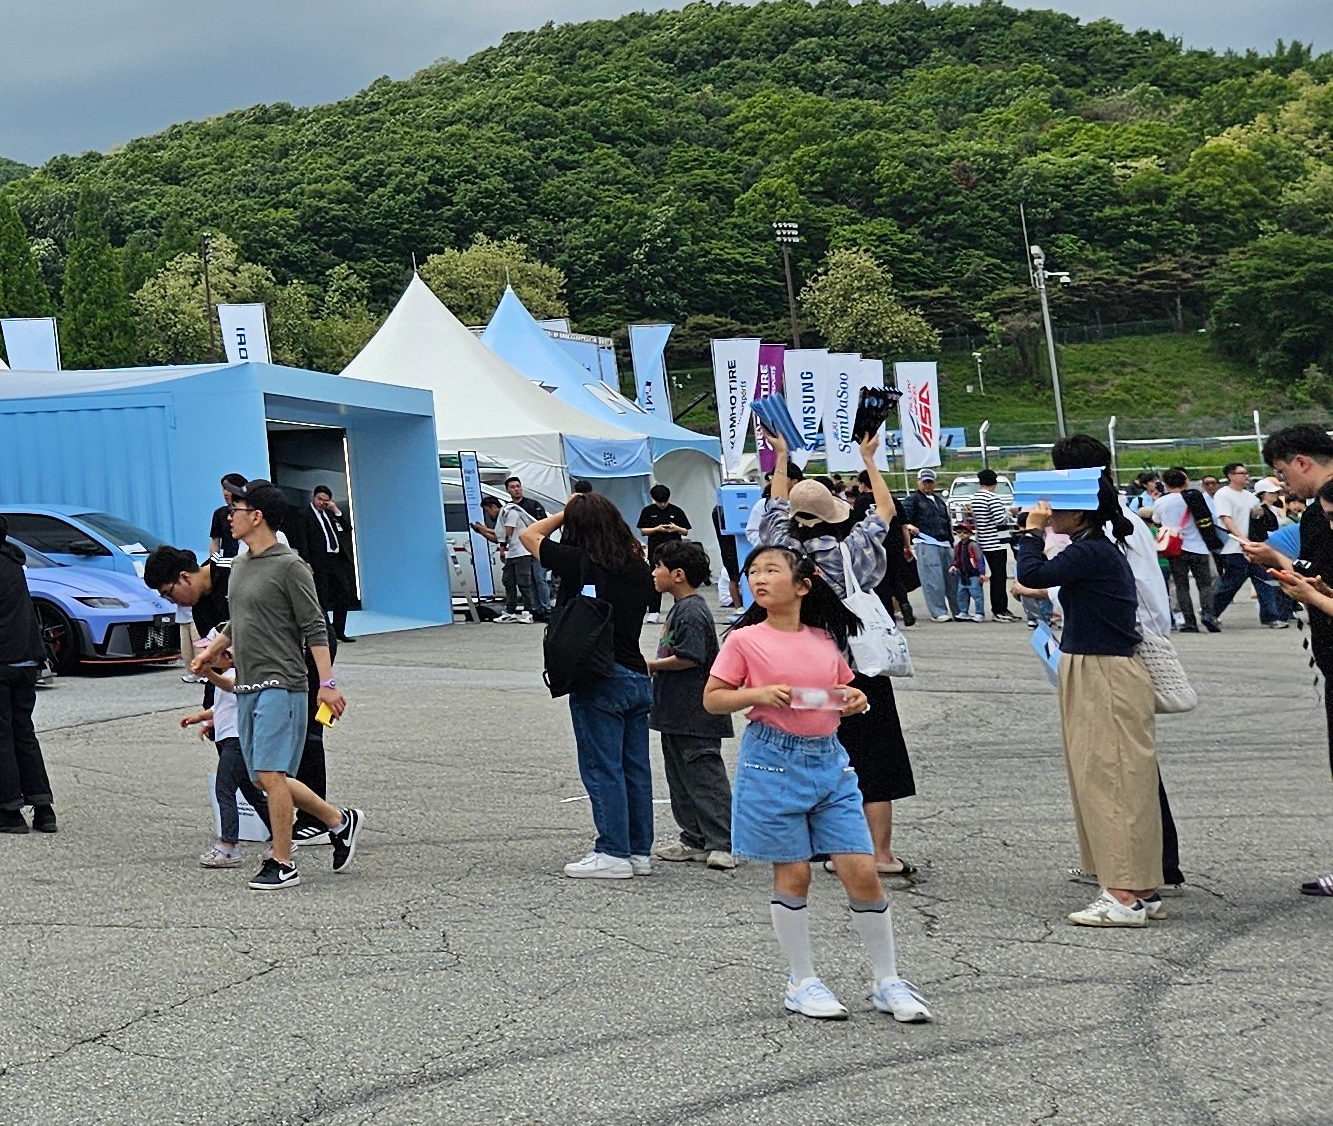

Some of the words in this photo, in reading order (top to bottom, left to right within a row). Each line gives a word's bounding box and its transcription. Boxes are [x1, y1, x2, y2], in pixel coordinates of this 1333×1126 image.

[727, 359, 737, 393] TIRE
[760, 364, 770, 399] TIRE
[800, 371, 818, 452] SAMSUNG
[836, 372, 852, 454] SamDaSoo
[918, 381, 933, 448] ASA
